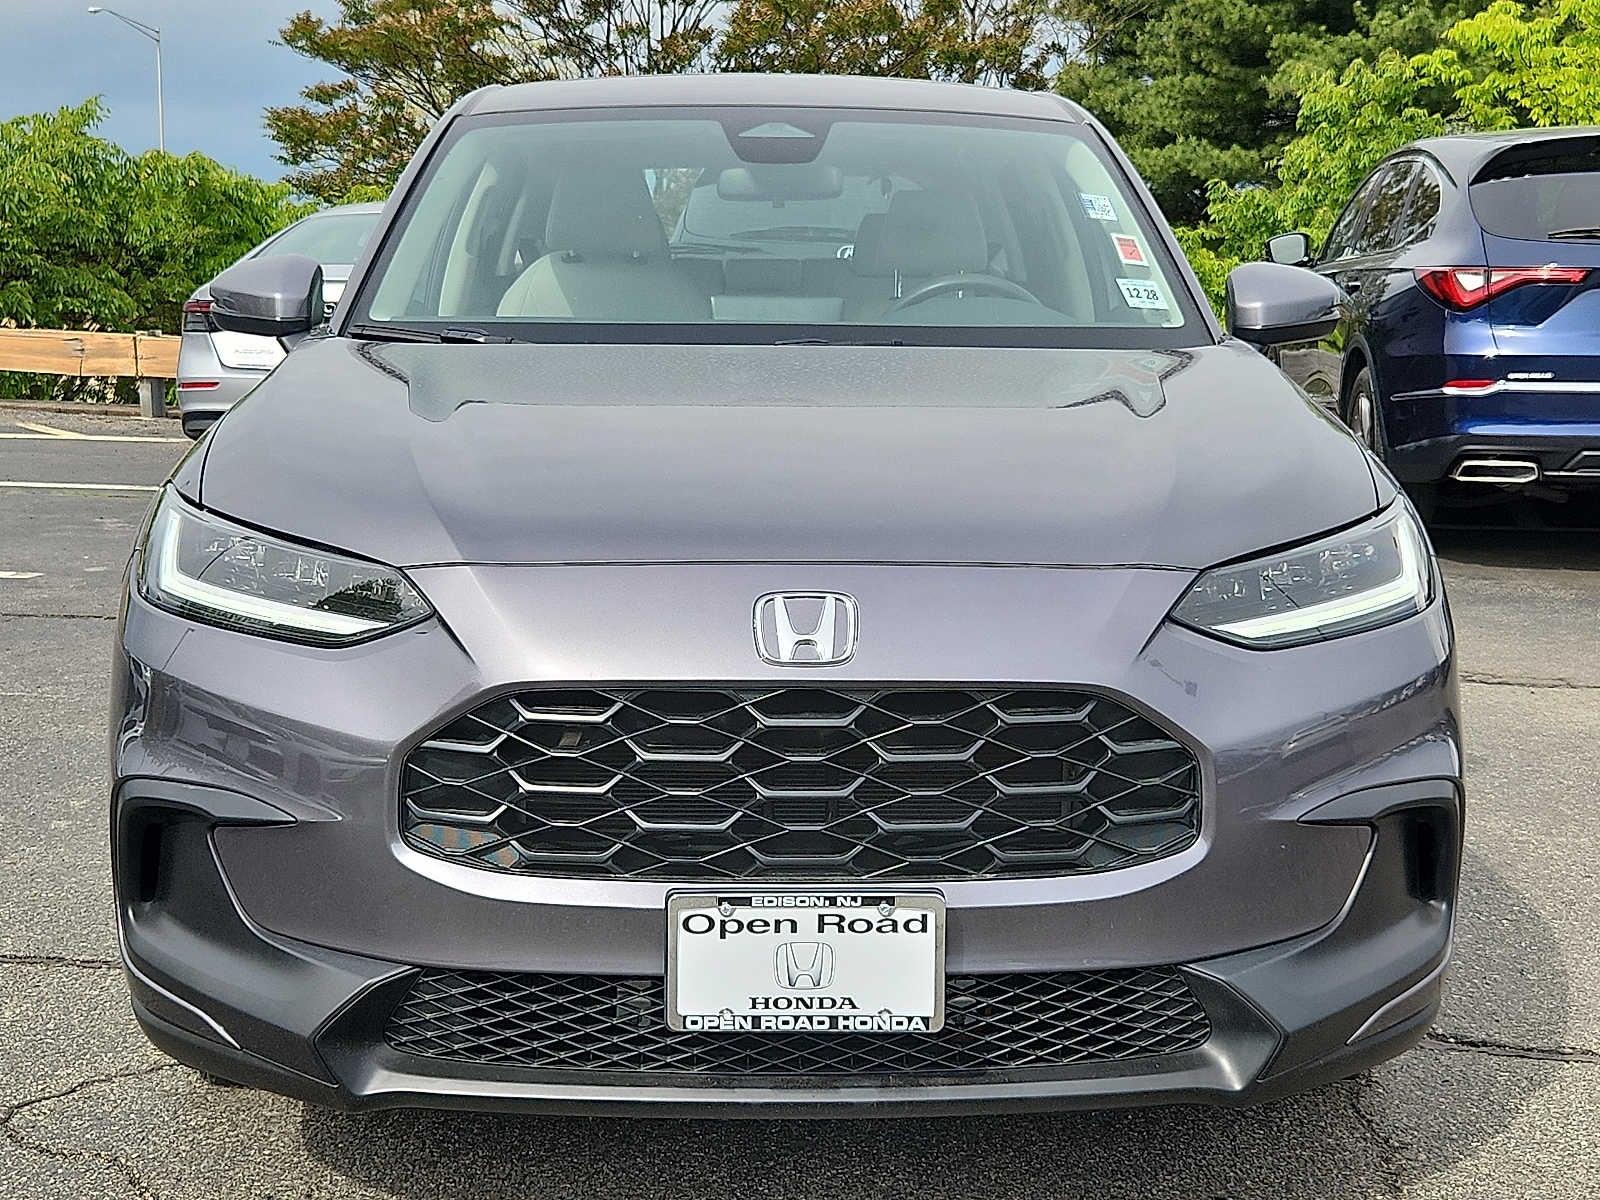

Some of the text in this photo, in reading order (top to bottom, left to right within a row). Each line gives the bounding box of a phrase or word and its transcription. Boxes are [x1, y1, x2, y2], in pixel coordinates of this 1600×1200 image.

[1126, 287, 1159, 301] 12 28
[836, 896, 862, 907] NJ
[682, 913, 928, 939] Open Road
[749, 996, 860, 1010] HONDA
[685, 1015, 927, 1031] OPEN ROAD HONDA
